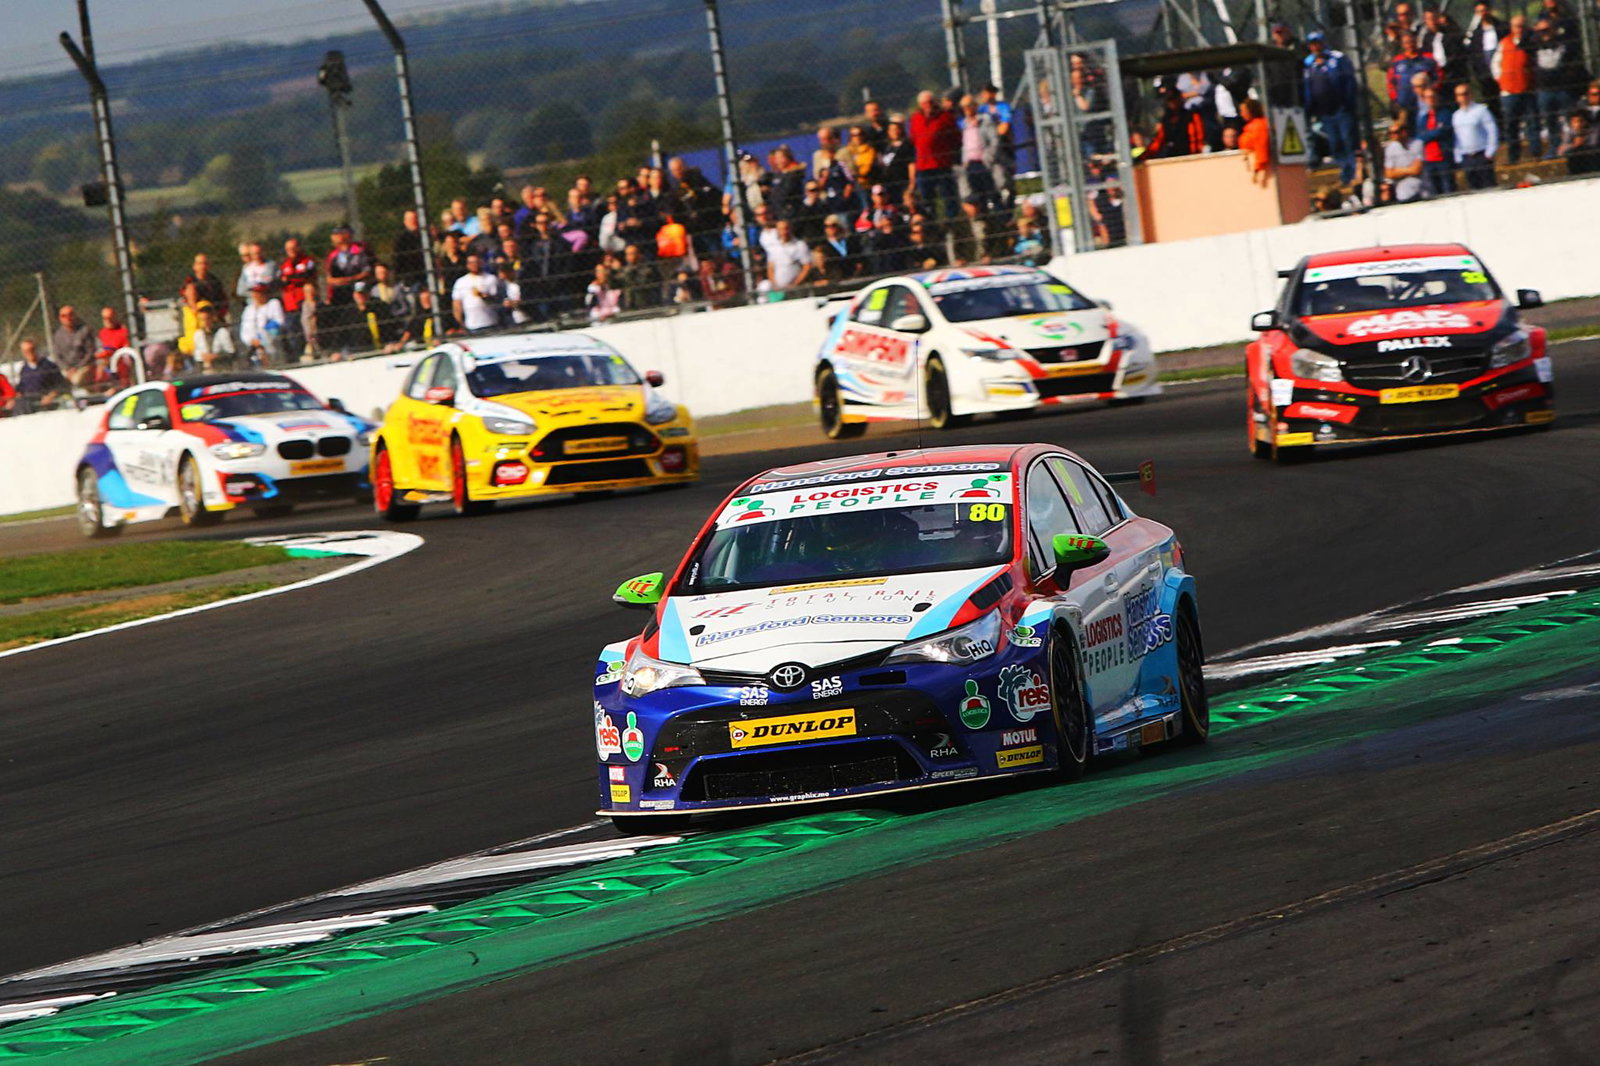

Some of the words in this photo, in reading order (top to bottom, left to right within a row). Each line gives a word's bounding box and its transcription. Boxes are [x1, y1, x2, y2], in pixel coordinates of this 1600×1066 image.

[749, 467, 883, 494] Hansford
[885, 461, 1001, 477] Sensors
[788, 490, 937, 514] PEOPLE
[792, 481, 940, 504] LOGISTICS
[968, 503, 1006, 522] 80
[770, 591, 853, 605] TOTAL
[696, 616, 810, 647] Hansford
[811, 614, 913, 625] Sensors
[1084, 613, 1124, 648] LOGISTICS
[968, 639, 992, 658] HiQ
[1088, 642, 1125, 676] PEOPLE
[740, 686, 769, 699] SAS
[811, 675, 843, 692] SAS
[1018, 674, 1050, 708] reis
[812, 687, 844, 700] ENERGY
[599, 716, 620, 747] reis
[752, 716, 854, 739] DUNLOP
[1002, 728, 1038, 746] MOTUL
[930, 747, 959, 759] RHA
[1006, 750, 1042, 763] DUNLOP
[653, 778, 677, 788] RHA
